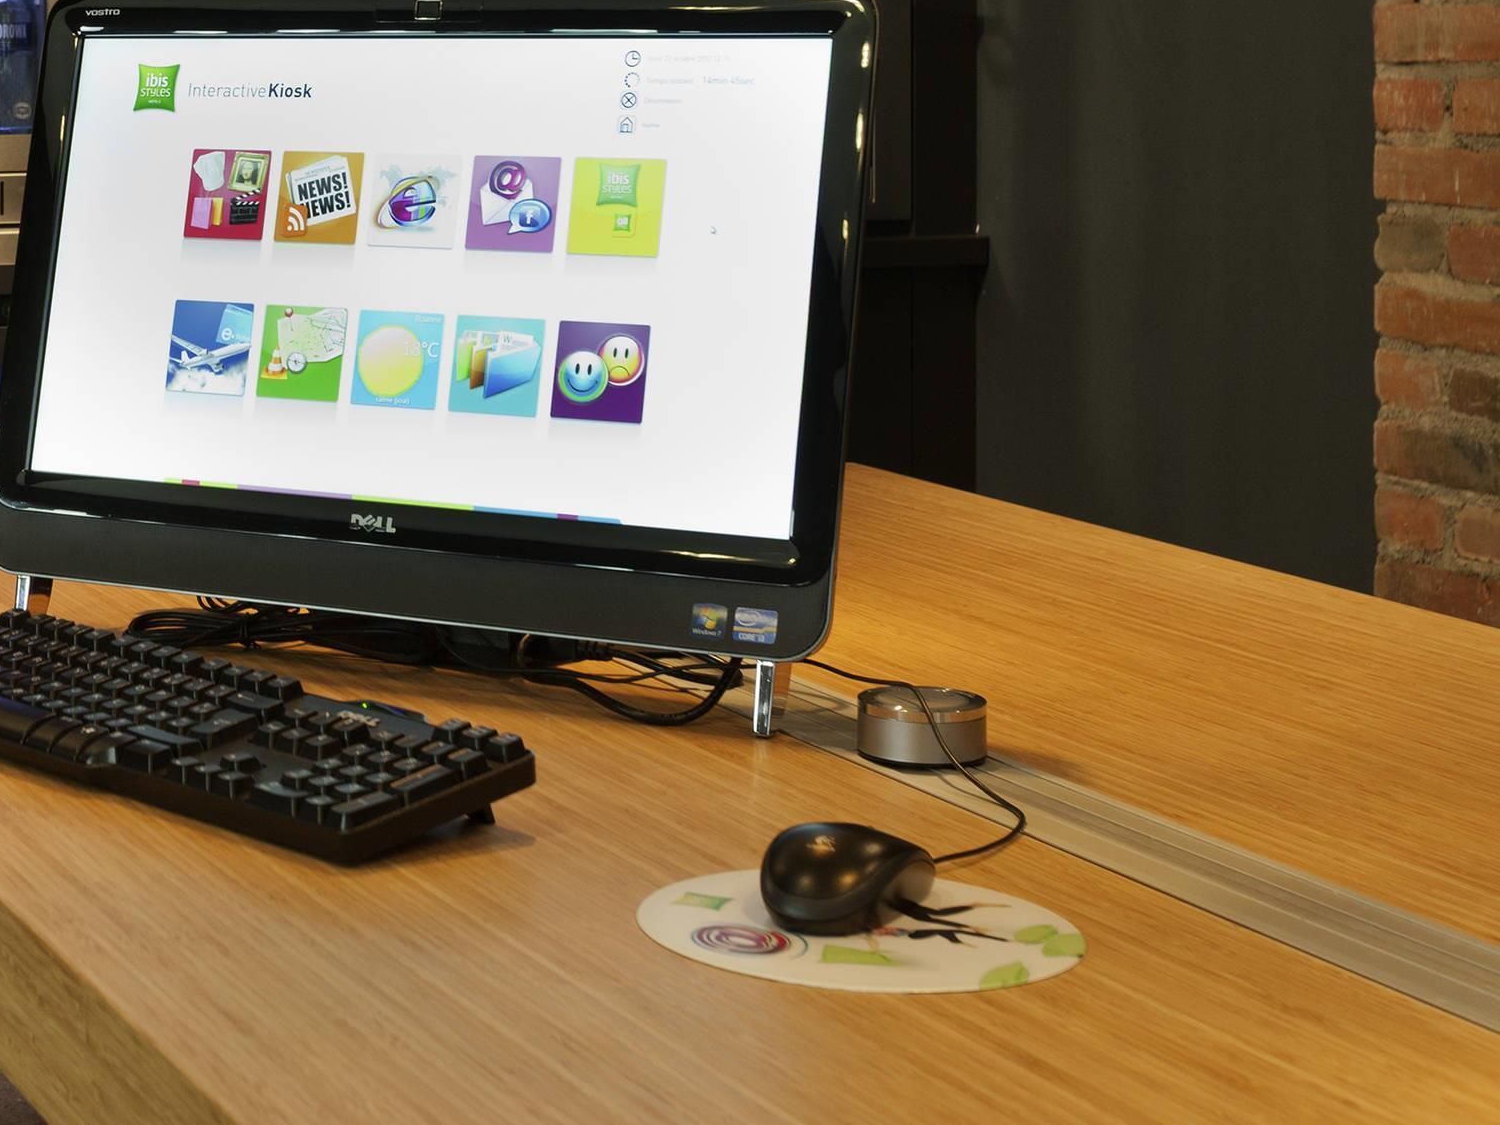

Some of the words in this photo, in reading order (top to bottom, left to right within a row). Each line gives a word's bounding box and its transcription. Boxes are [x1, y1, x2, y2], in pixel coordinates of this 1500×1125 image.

[145, 72, 169, 88] ibis
[297, 171, 348, 202] NEWS!
[607, 171, 630, 185] ibis
[350, 513, 397, 533] DELL
